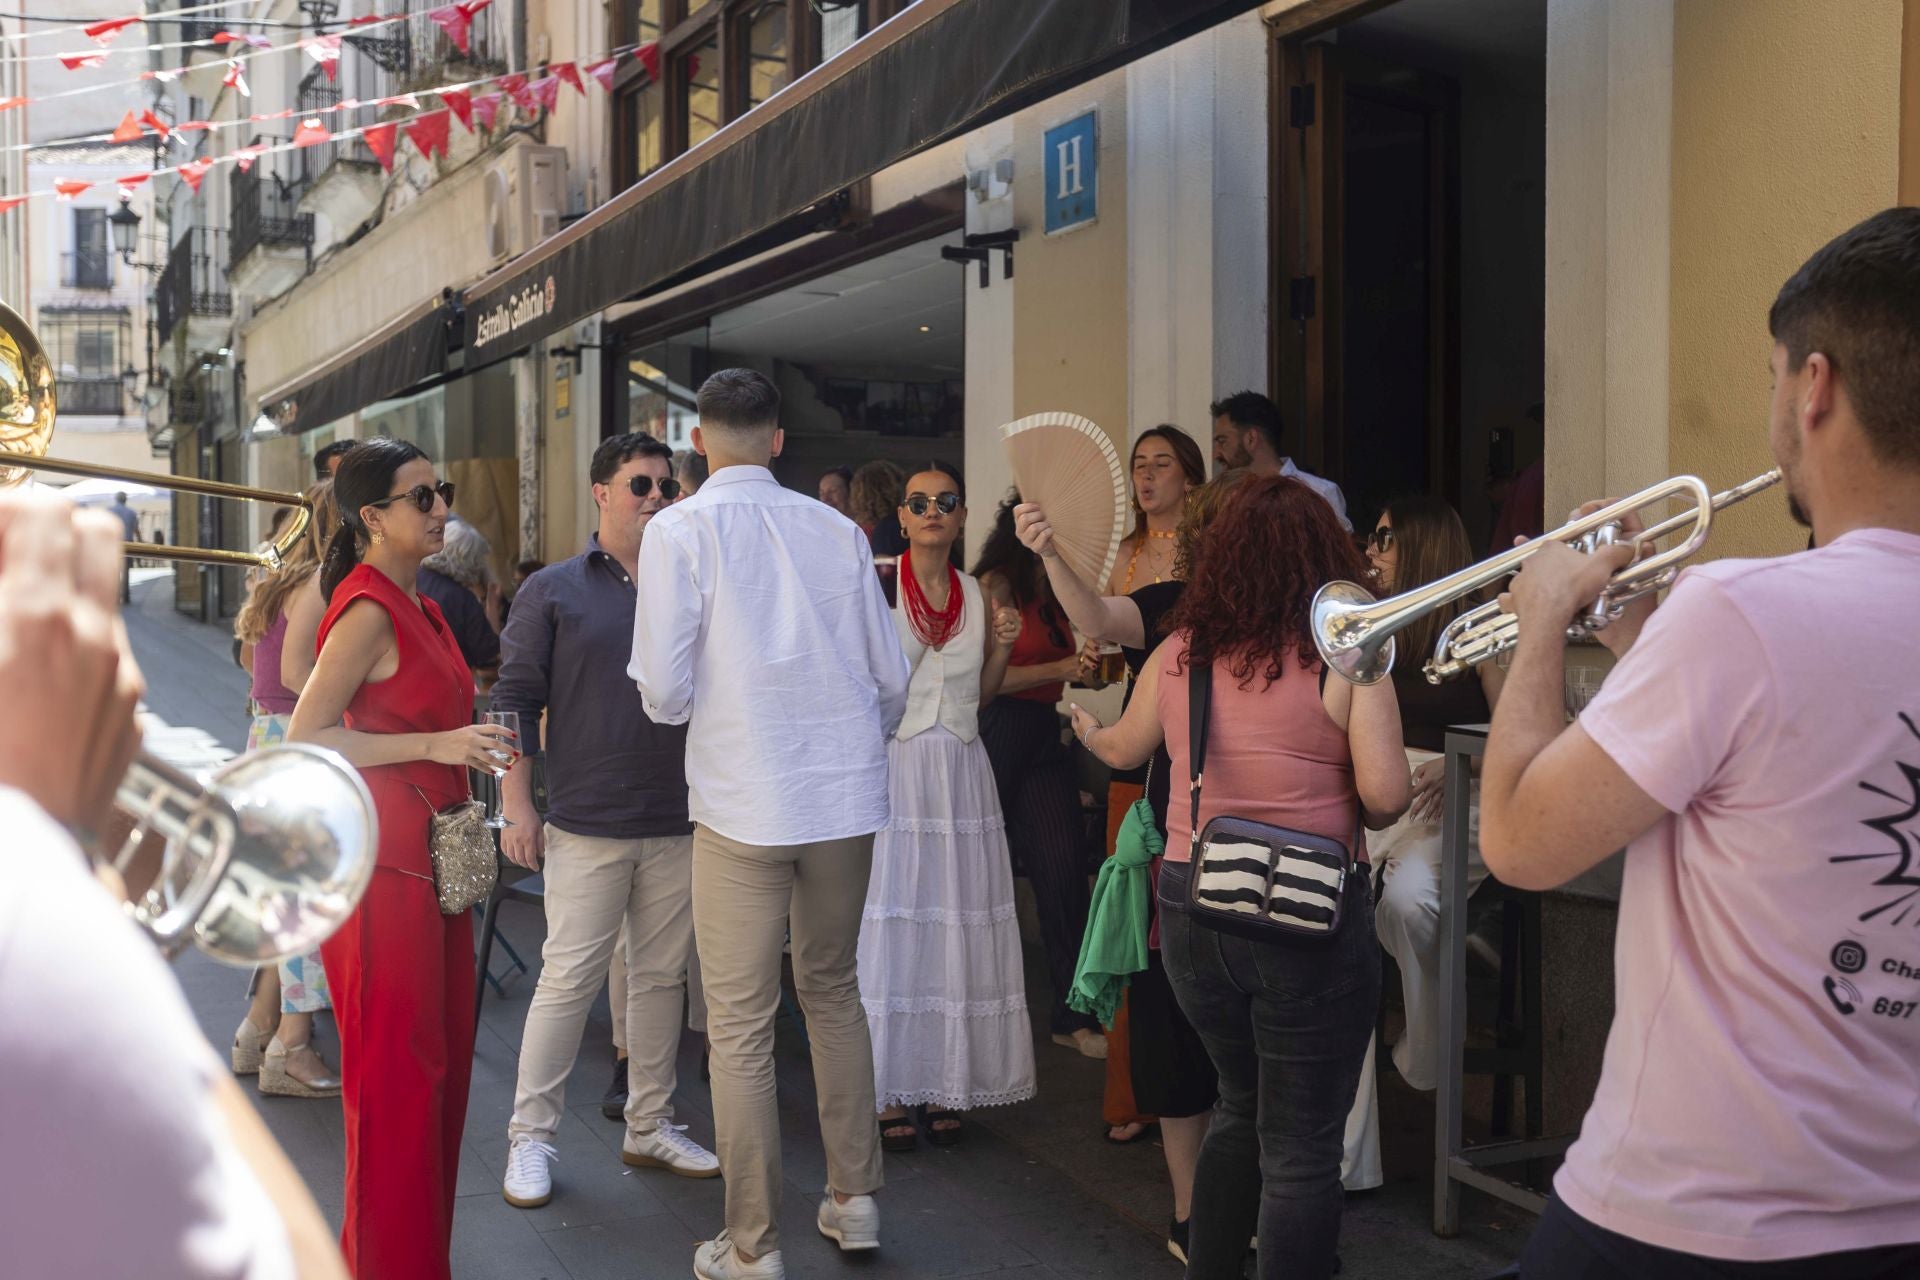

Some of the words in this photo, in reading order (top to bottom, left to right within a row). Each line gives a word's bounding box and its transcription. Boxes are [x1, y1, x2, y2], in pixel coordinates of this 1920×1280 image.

[1057, 135, 1083, 199] H
[473, 304, 510, 347] Estrella
[509, 283, 544, 330] Galicia
[1872, 996, 1918, 1018] 697
